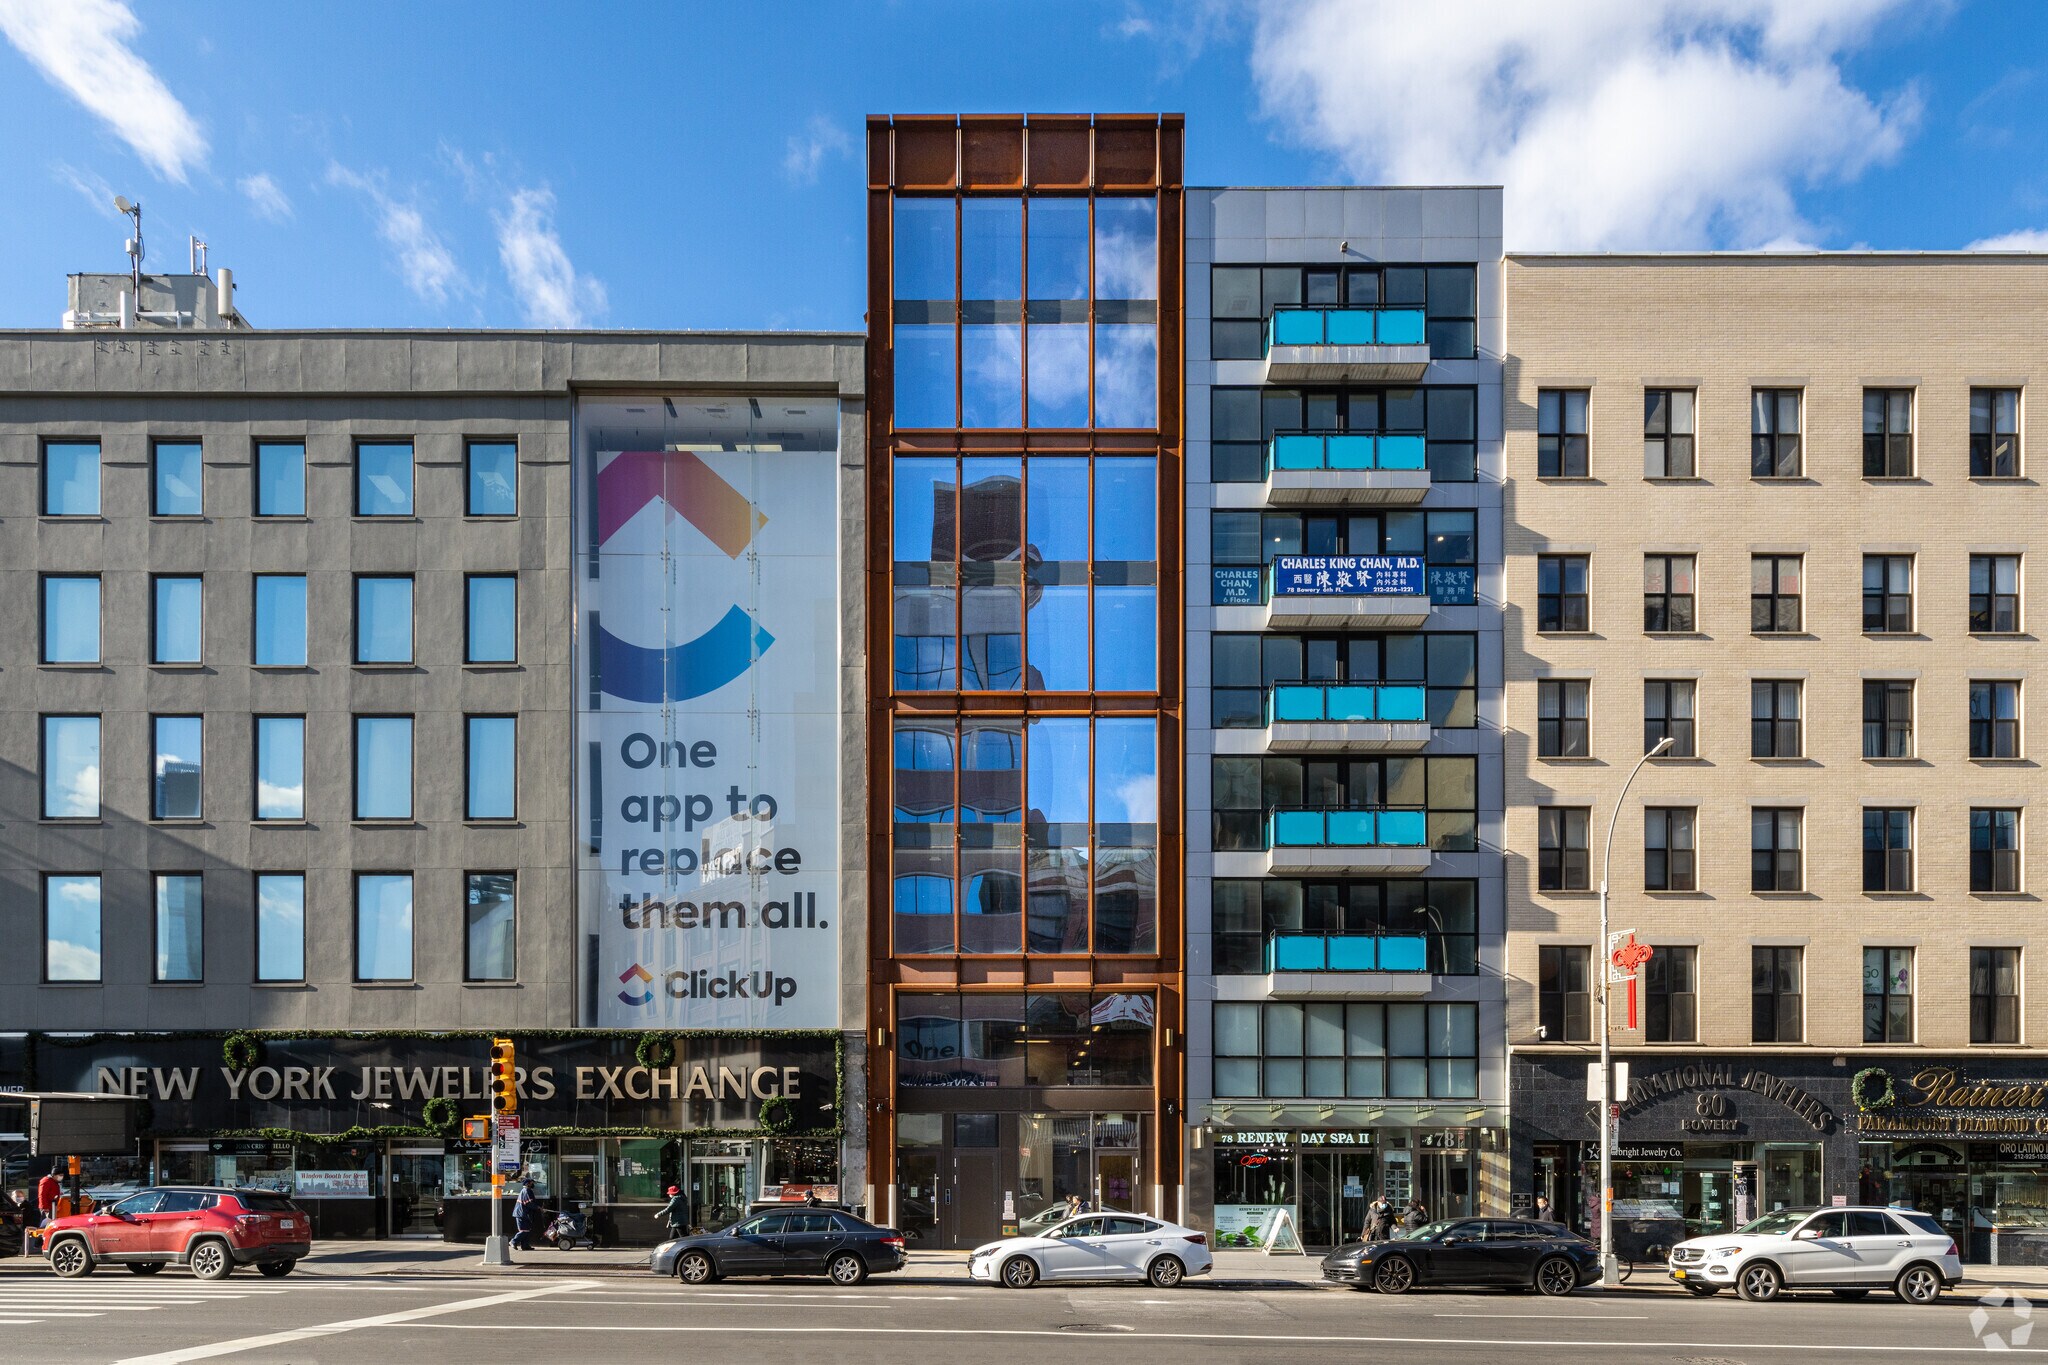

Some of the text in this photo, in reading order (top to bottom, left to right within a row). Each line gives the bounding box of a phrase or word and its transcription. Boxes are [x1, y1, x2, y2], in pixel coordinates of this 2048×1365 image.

[1281, 558, 1420, 570] CHARLES KING CHAN, M.D.
[1215, 571, 1258, 579] CHARLES
[1220, 580, 1252, 588] CHAN,
[621, 732, 717, 769] One
[621, 785, 778, 832] app to
[621, 838, 802, 886] replace
[619, 892, 829, 929] them all.
[665, 969, 797, 1006] ClickUp
[99, 1066, 200, 1100] NEW
[220, 1066, 337, 1100] YORK
[575, 1066, 801, 1100] EXCHANGE
[1696, 1093, 1726, 1117] 80
[1741, 1068, 1833, 1131] JEWELERS
[1681, 1119, 1738, 1131] BOWERY
[1858, 1116, 1951, 1132] PARAMOUNT
[1957, 1116, 2030, 1132] DIAMOND
[1221, 1132, 1369, 1144] 78 RENEW DAY SPA II
[1434, 1132, 1455, 1147] 78
[1640, 1147, 1669, 1158] Jewelry
[1671, 1147, 1682, 1157] Co.
[2000, 1143, 2016, 1153] ORO
[2018, 1143, 2044, 1153] LATINO
[1240, 1154, 1269, 1166] Open
